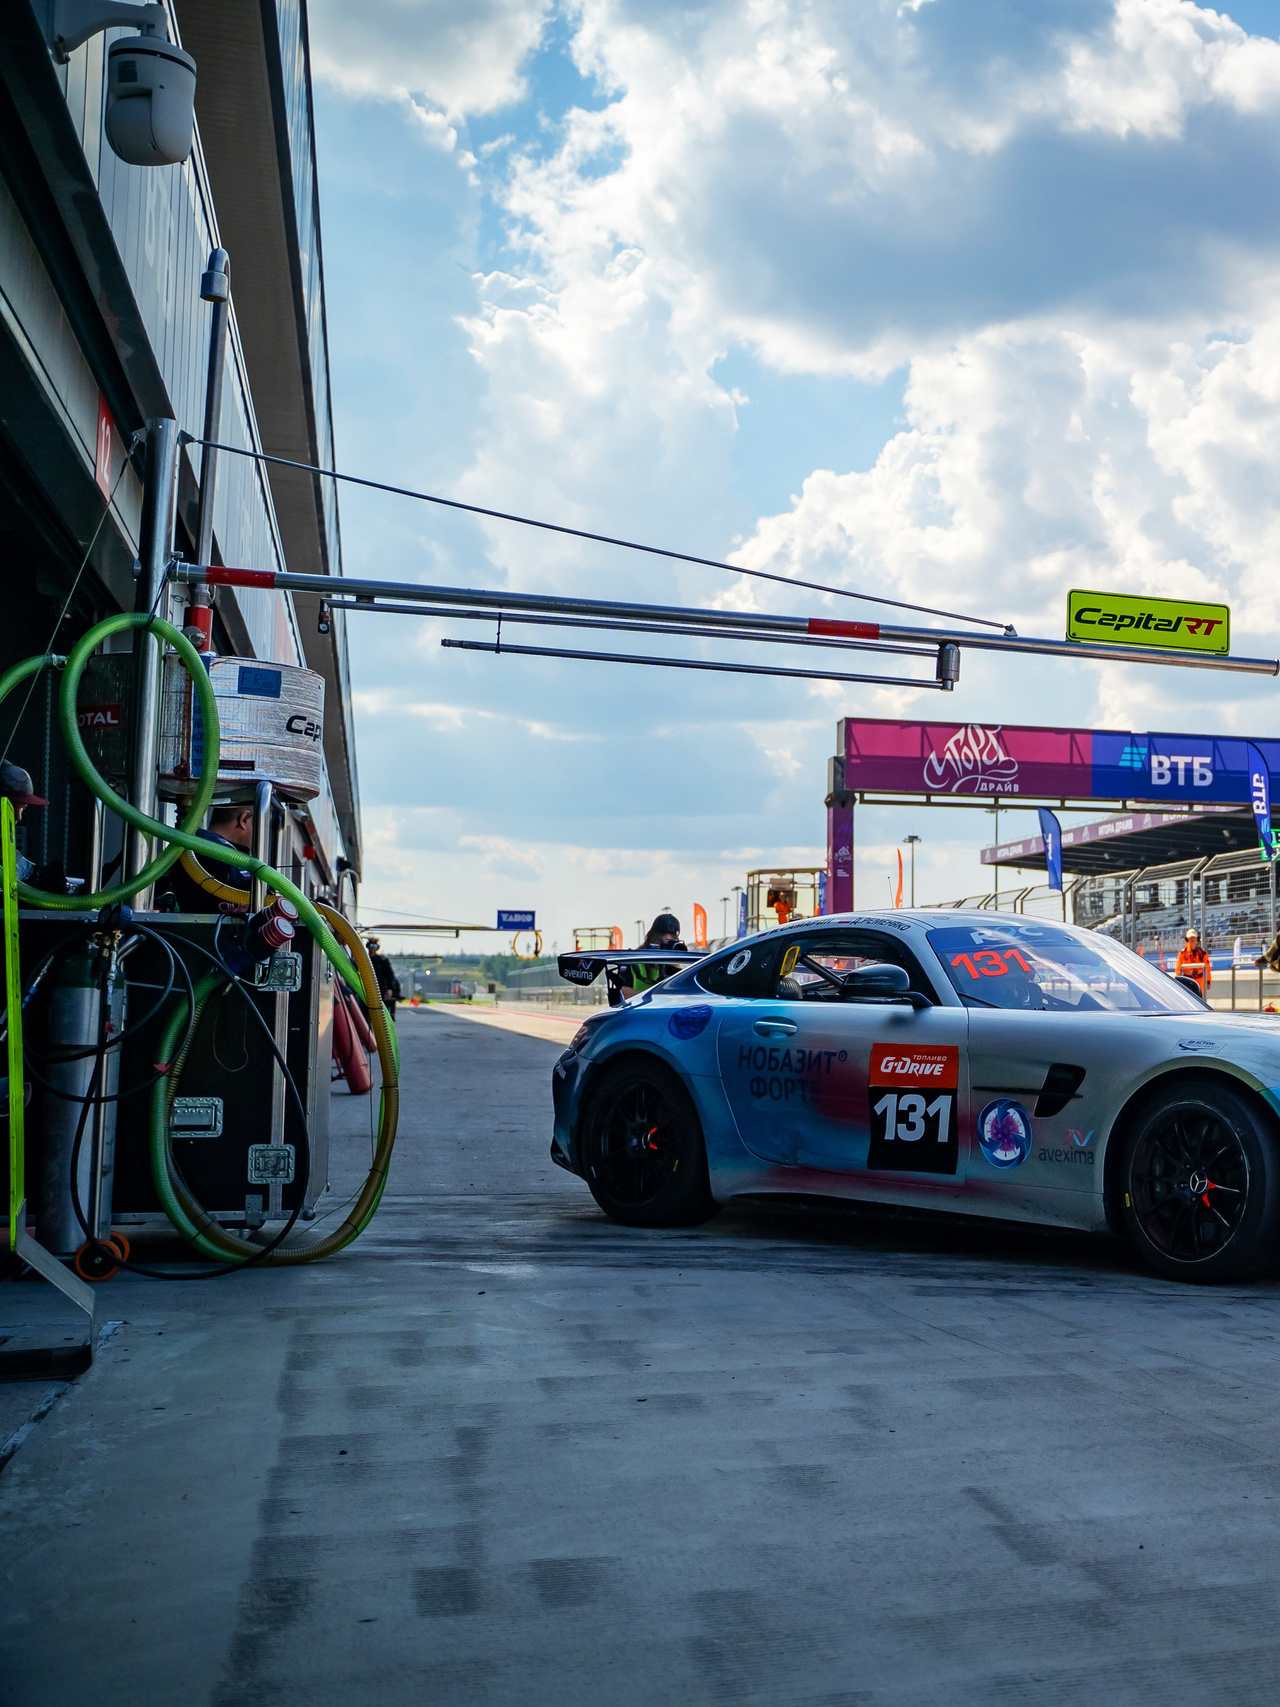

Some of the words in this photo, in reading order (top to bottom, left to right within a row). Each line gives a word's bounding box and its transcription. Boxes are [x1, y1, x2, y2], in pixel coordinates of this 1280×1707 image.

[100, 417, 111, 484] 12
[77, 711, 119, 727] OTAL
[285, 714, 322, 742] Cap
[1151, 753, 1213, 787] ВТБ
[979, 781, 1020, 793] ДРАЙВ
[563, 968, 593, 980] avexima
[950, 949, 1031, 979] 131
[873, 1093, 952, 1143] 131
[1039, 1146, 1094, 1165] avexima
